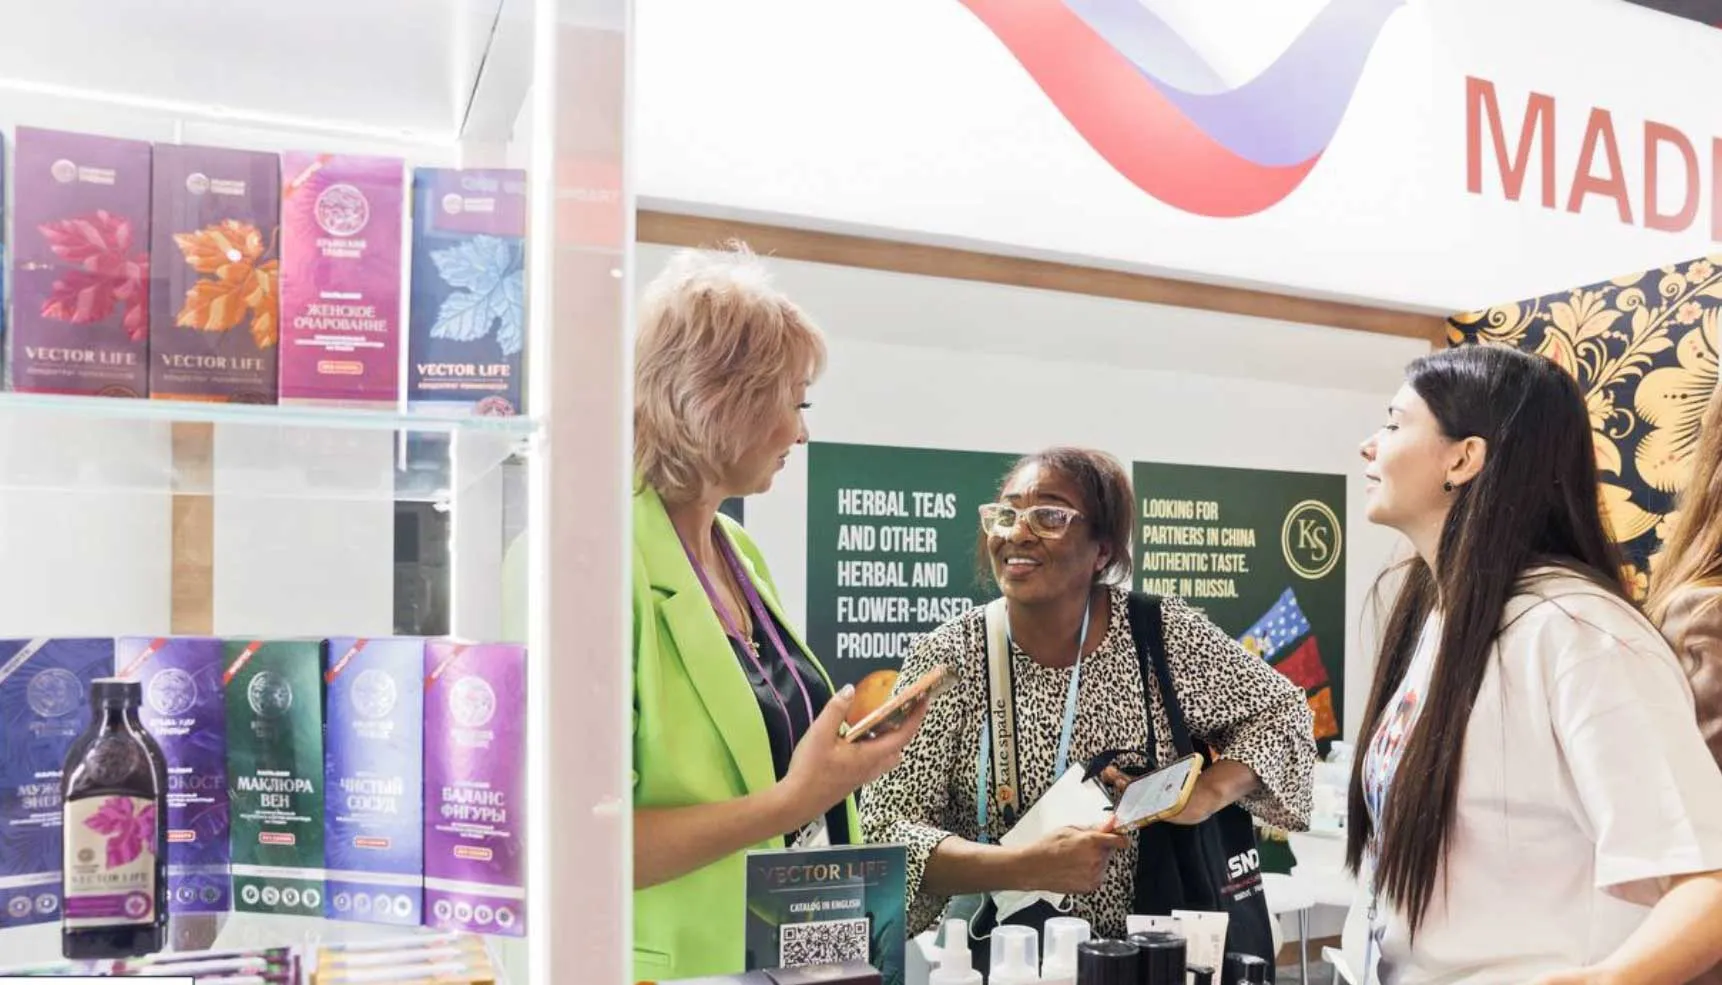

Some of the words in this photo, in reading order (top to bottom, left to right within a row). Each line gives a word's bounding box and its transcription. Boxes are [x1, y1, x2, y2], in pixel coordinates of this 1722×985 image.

[1465, 75, 1722, 242] MAD
[306, 303, 376, 318] ЖЕНСКОЕ
[293, 317, 388, 332] ОЧАРОВАНИЕ
[25, 346, 95, 363] VECTOR
[100, 350, 137, 366] LIFE
[161, 353, 226, 369] VECTOR
[231, 356, 265, 371] LIFE
[417, 363, 475, 377] VECTOR
[479, 363, 511, 377] LIFE
[837, 488, 909, 518] HERBAL
[912, 491, 957, 519] TEAS
[1142, 498, 1194, 519] LOOKING
[1196, 500, 1219, 520] FOR
[837, 525, 876, 551] AND
[880, 526, 937, 553] OTHER
[1142, 525, 1206, 546] PARTNERS
[1206, 527, 1219, 546] IN
[1221, 528, 1256, 547] CHINA
[1297, 519, 1328, 561] KS
[1142, 551, 1209, 572] AUTHENTIC
[1210, 553, 1249, 573] TASTE.
[837, 560, 908, 587] HERBAL
[911, 562, 949, 588] AND
[1142, 578, 1178, 597] MADE
[1180, 579, 1192, 597] IN
[1194, 579, 1239, 598] RUSSIA.
[993, 698, 1012, 747] spade
[237, 776, 314, 794] МАКЛЮРА
[260, 793, 290, 808] ВЕН
[442, 786, 505, 806] БАЛАНС
[440, 803, 506, 824] ФИГУРЫ
[759, 864, 840, 883] VECTOR
[848, 860, 888, 879] LIFE
[790, 901, 821, 913] CATALOG
[822, 901, 830, 911] IN
[831, 899, 861, 910] ENGLISH
